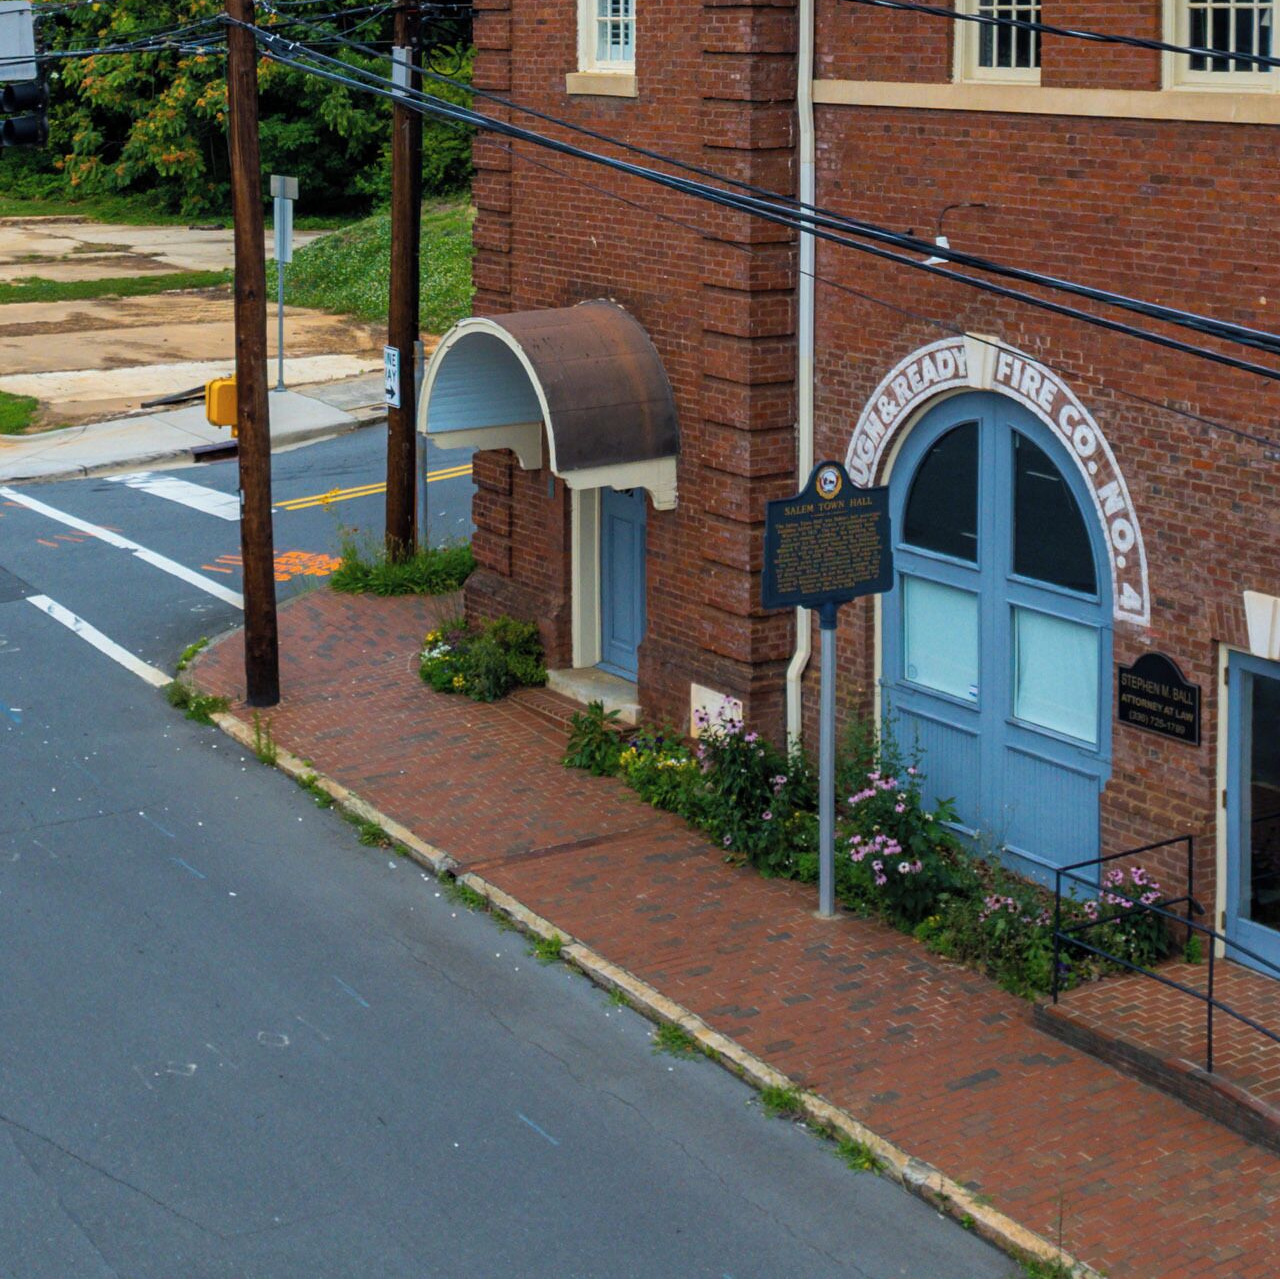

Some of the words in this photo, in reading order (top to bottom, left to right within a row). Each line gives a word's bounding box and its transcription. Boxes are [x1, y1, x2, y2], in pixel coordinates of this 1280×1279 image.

[877, 394, 902, 424] &
[894, 347, 968, 411] READY
[996, 352, 1061, 411] FIRE
[1058, 404, 1098, 474] CO.
[1097, 481, 1135, 568] NO.
[1119, 582, 1142, 610] 4
[783, 504, 814, 516] SALEM
[818, 502, 845, 512] TOWN
[850, 497, 873, 508] HALL
[1121, 673, 1160, 695] STEPHEN
[1161, 683, 1172, 698] M.
[1172, 687, 1194, 706] BALL
[1121, 693, 1164, 712] ATTORNEY
[1163, 705, 1175, 716] AT
[1175, 708, 1194, 722] LAW
